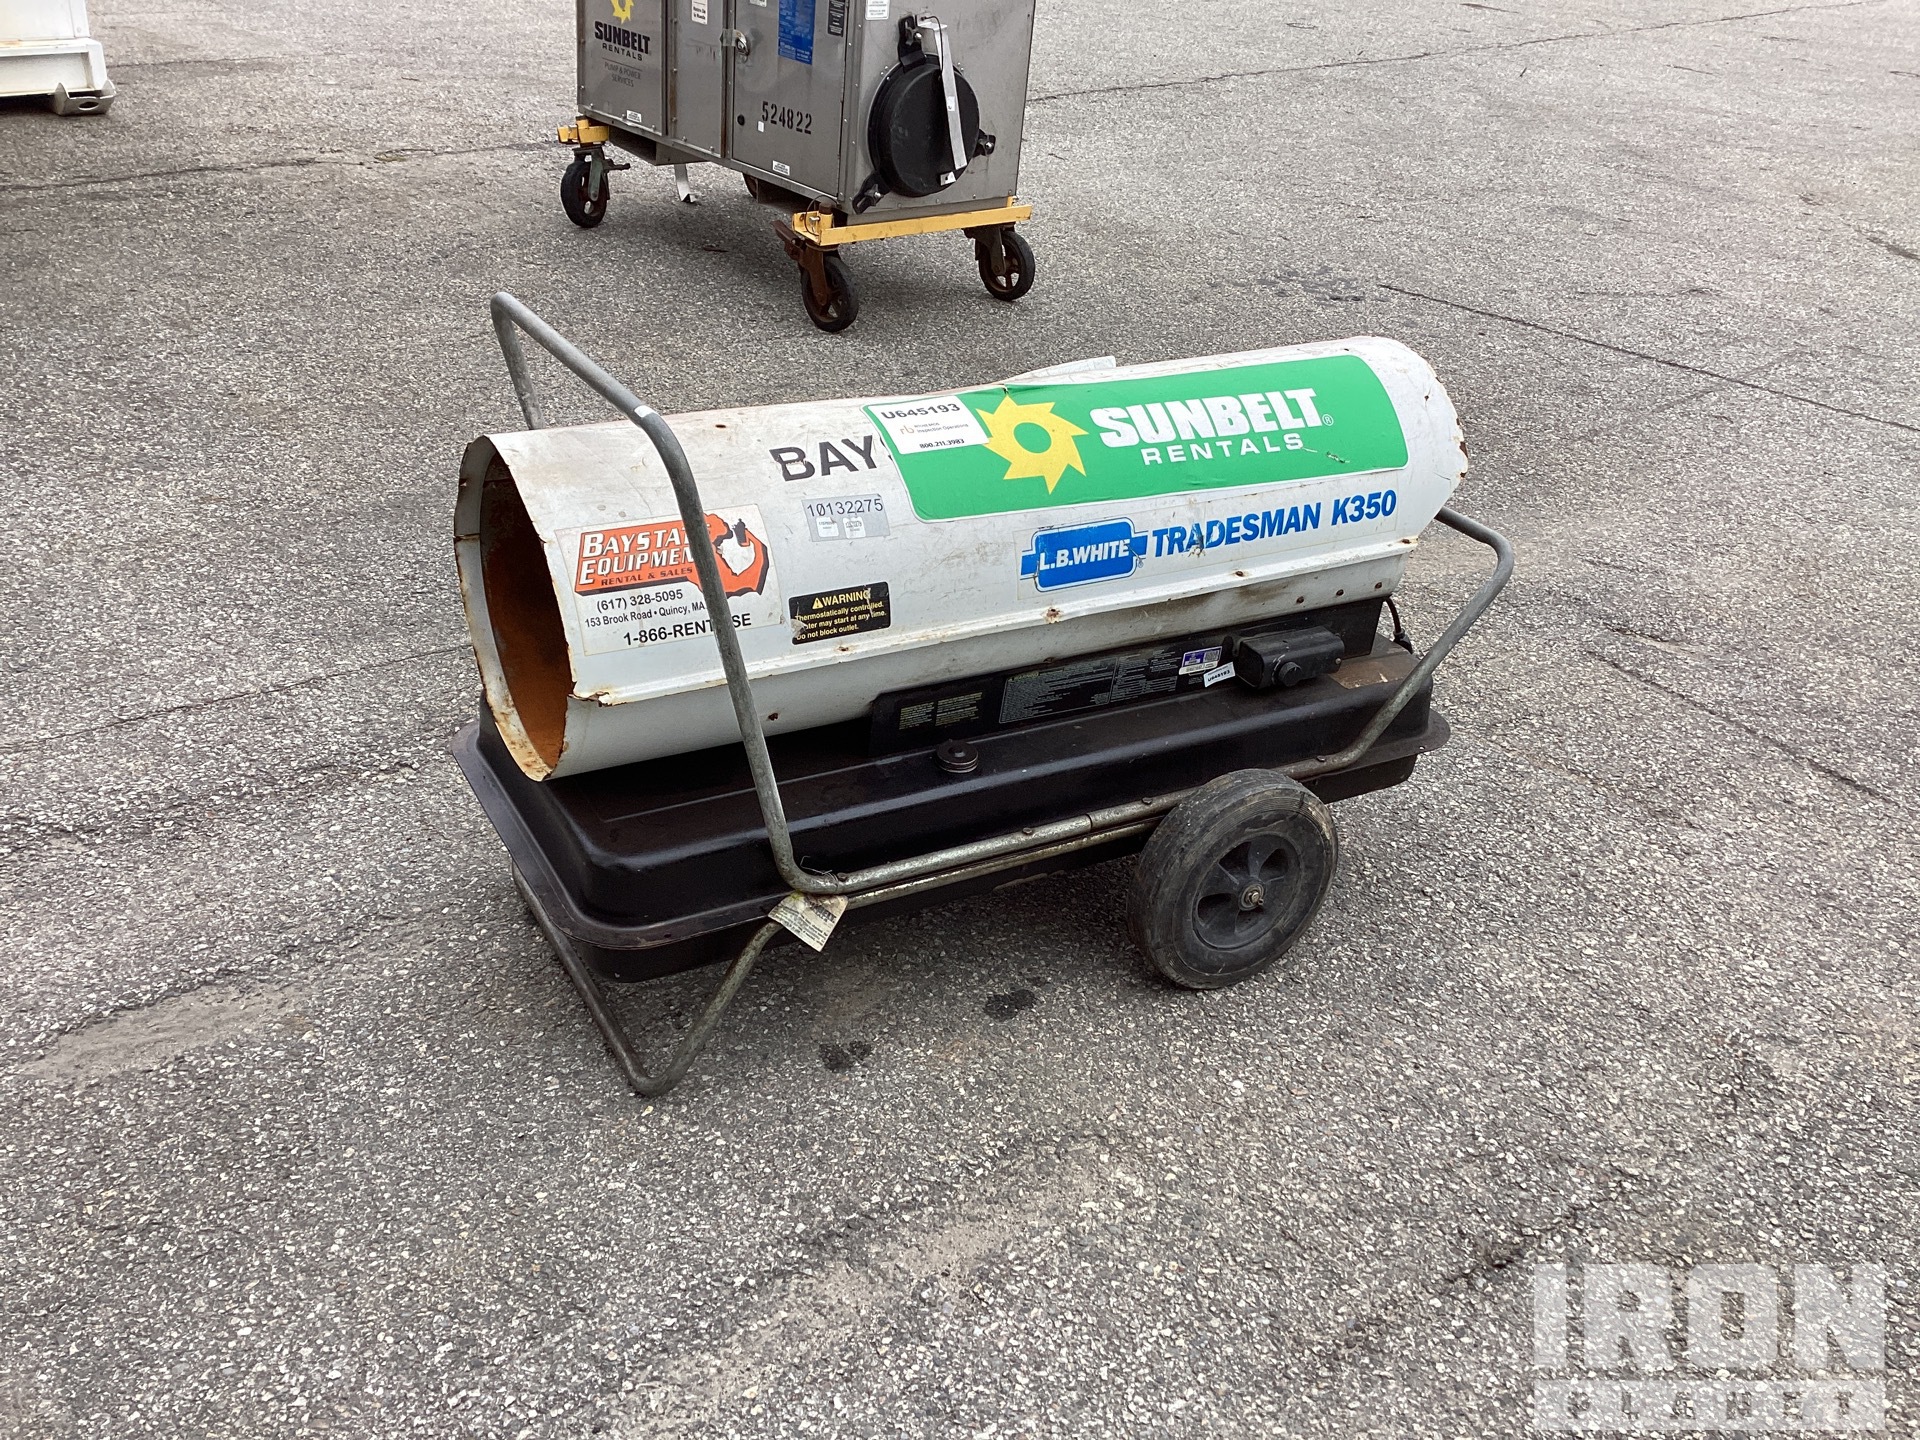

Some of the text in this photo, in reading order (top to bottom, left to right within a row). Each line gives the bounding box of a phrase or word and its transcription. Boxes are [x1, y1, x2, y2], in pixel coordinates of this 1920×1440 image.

[594, 20, 650, 54] SUNBELT
[602, 43, 643, 61] RENTALS
[605, 61, 619, 73] PUMP
[623, 68, 641, 80] POWER
[611, 73, 634, 87] SERVICES
[762, 101, 812, 135] 524822
[881, 403, 961, 419] U645193
[1090, 388, 1323, 448] SUNBELT
[769, 434, 893, 482] BAY
[1141, 433, 1304, 466] RENTALS
[807, 498, 883, 517] 10132275
[1152, 489, 1397, 558] TRADESMAN K350
[582, 524, 712, 558] BAYSTA
[579, 546, 696, 585] EQUIPMEN
[1040, 538, 1131, 571] L.B.WHITE
[601, 566, 693, 586] RENTAL & SALES
[596, 588, 683, 613] (617) 328-5095
[822, 590, 871, 606] WARNING
[585, 617, 601, 628] 153
[603, 614, 629, 625] Brook
[630, 609, 653, 621] Road
[659, 605, 691, 617] Quincy,
[795, 601, 884, 621] Thermostatically controlled.
[819, 619, 833, 629] may
[834, 615, 850, 625] start
[858, 613, 870, 622] any
[623, 613, 752, 645] 1-866-RENTSE
[807, 630, 819, 639] not
[820, 626, 838, 636] block
